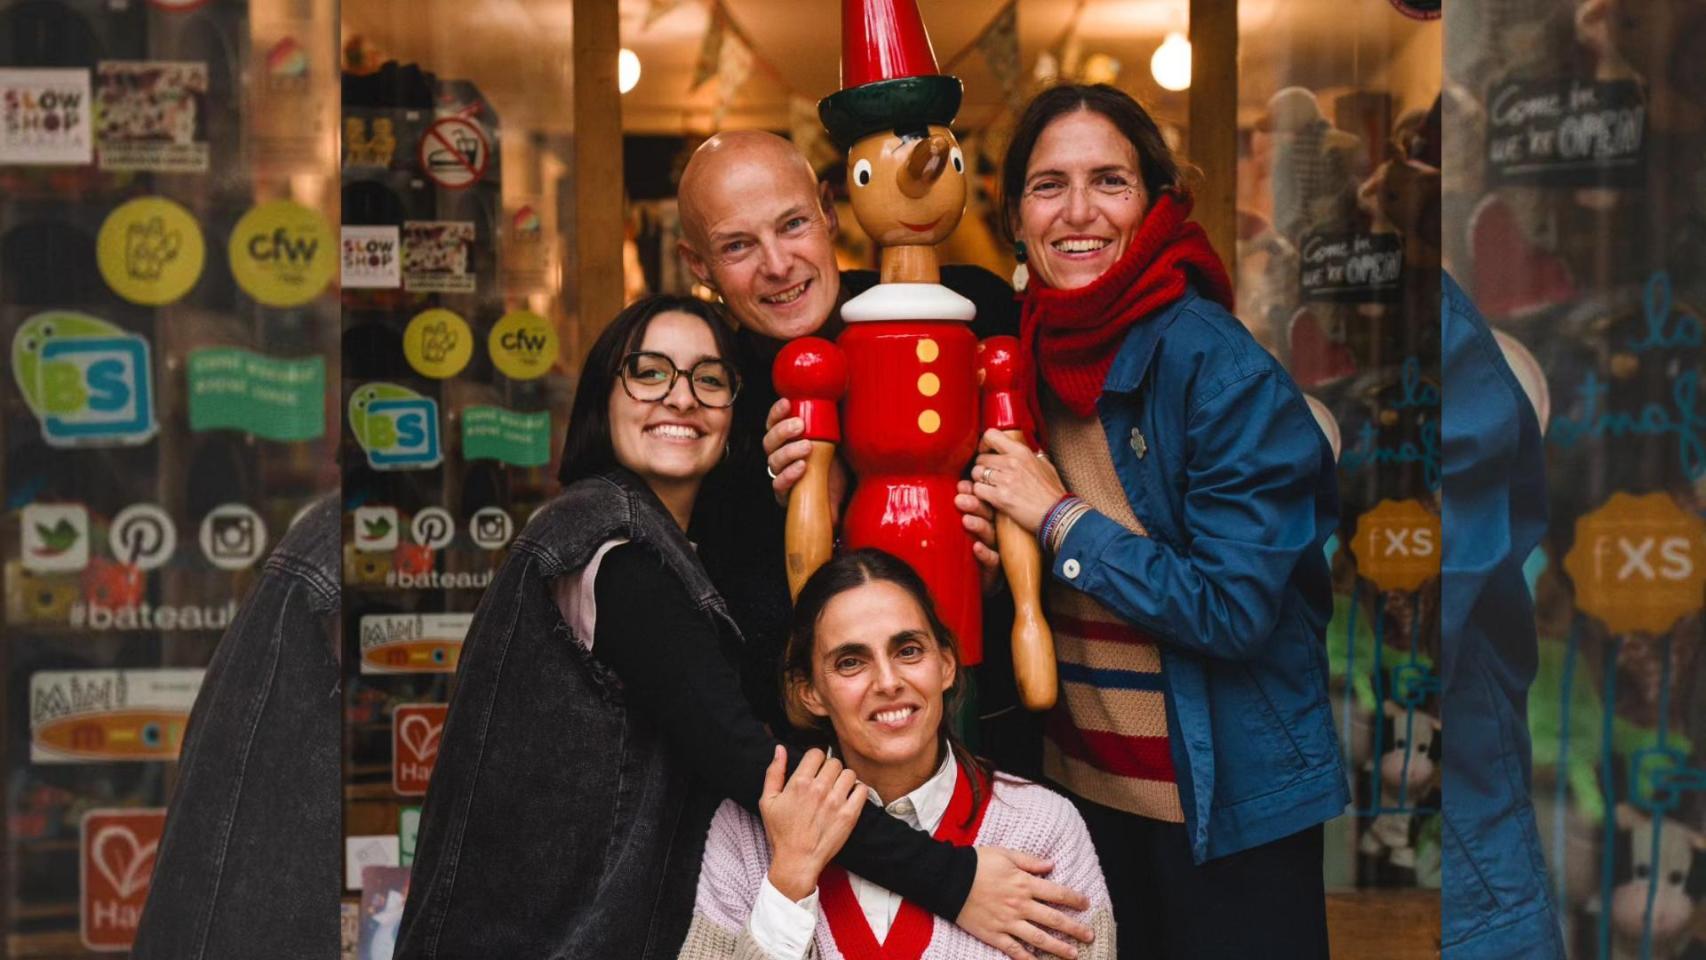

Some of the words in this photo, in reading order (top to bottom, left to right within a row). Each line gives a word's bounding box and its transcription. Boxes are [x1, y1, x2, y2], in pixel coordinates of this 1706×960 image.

[4, 88, 82, 109] SLOW
[5, 111, 81, 132] SHOP
[248, 227, 319, 261] cfw
[343, 239, 395, 253] SLOW
[344, 254, 393, 267] SHOP
[501, 328, 546, 350] cfw
